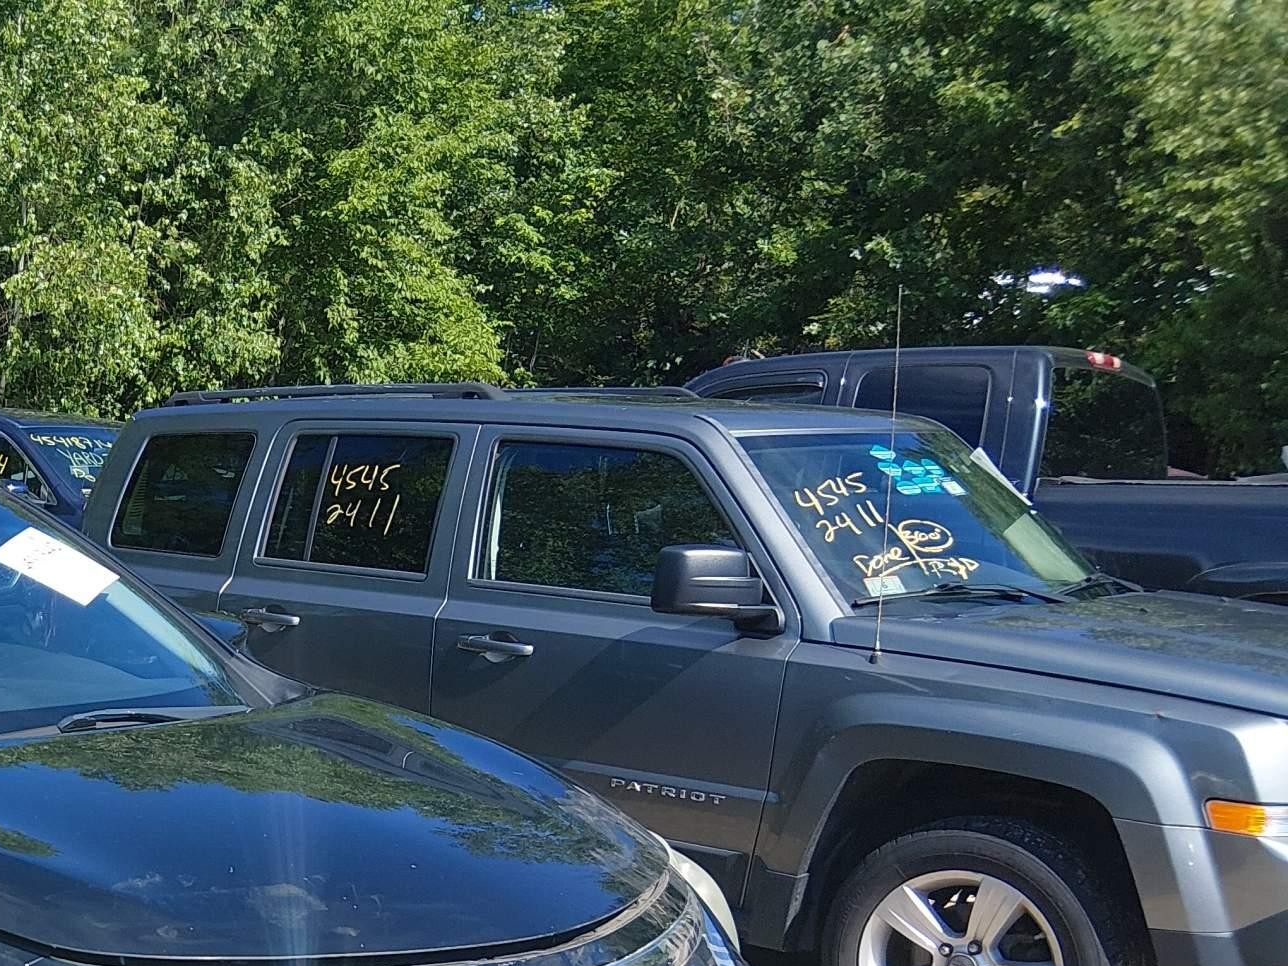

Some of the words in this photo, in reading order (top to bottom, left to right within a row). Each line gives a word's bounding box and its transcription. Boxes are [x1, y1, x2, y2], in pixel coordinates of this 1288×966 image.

[72, 467, 97, 483] Do
[331, 464, 401, 497] 4545
[794, 472, 867, 516] 4545
[326, 494, 400, 536] 2411
[815, 500, 885, 543] 2411
[610, 778, 727, 805] PATRIOT
